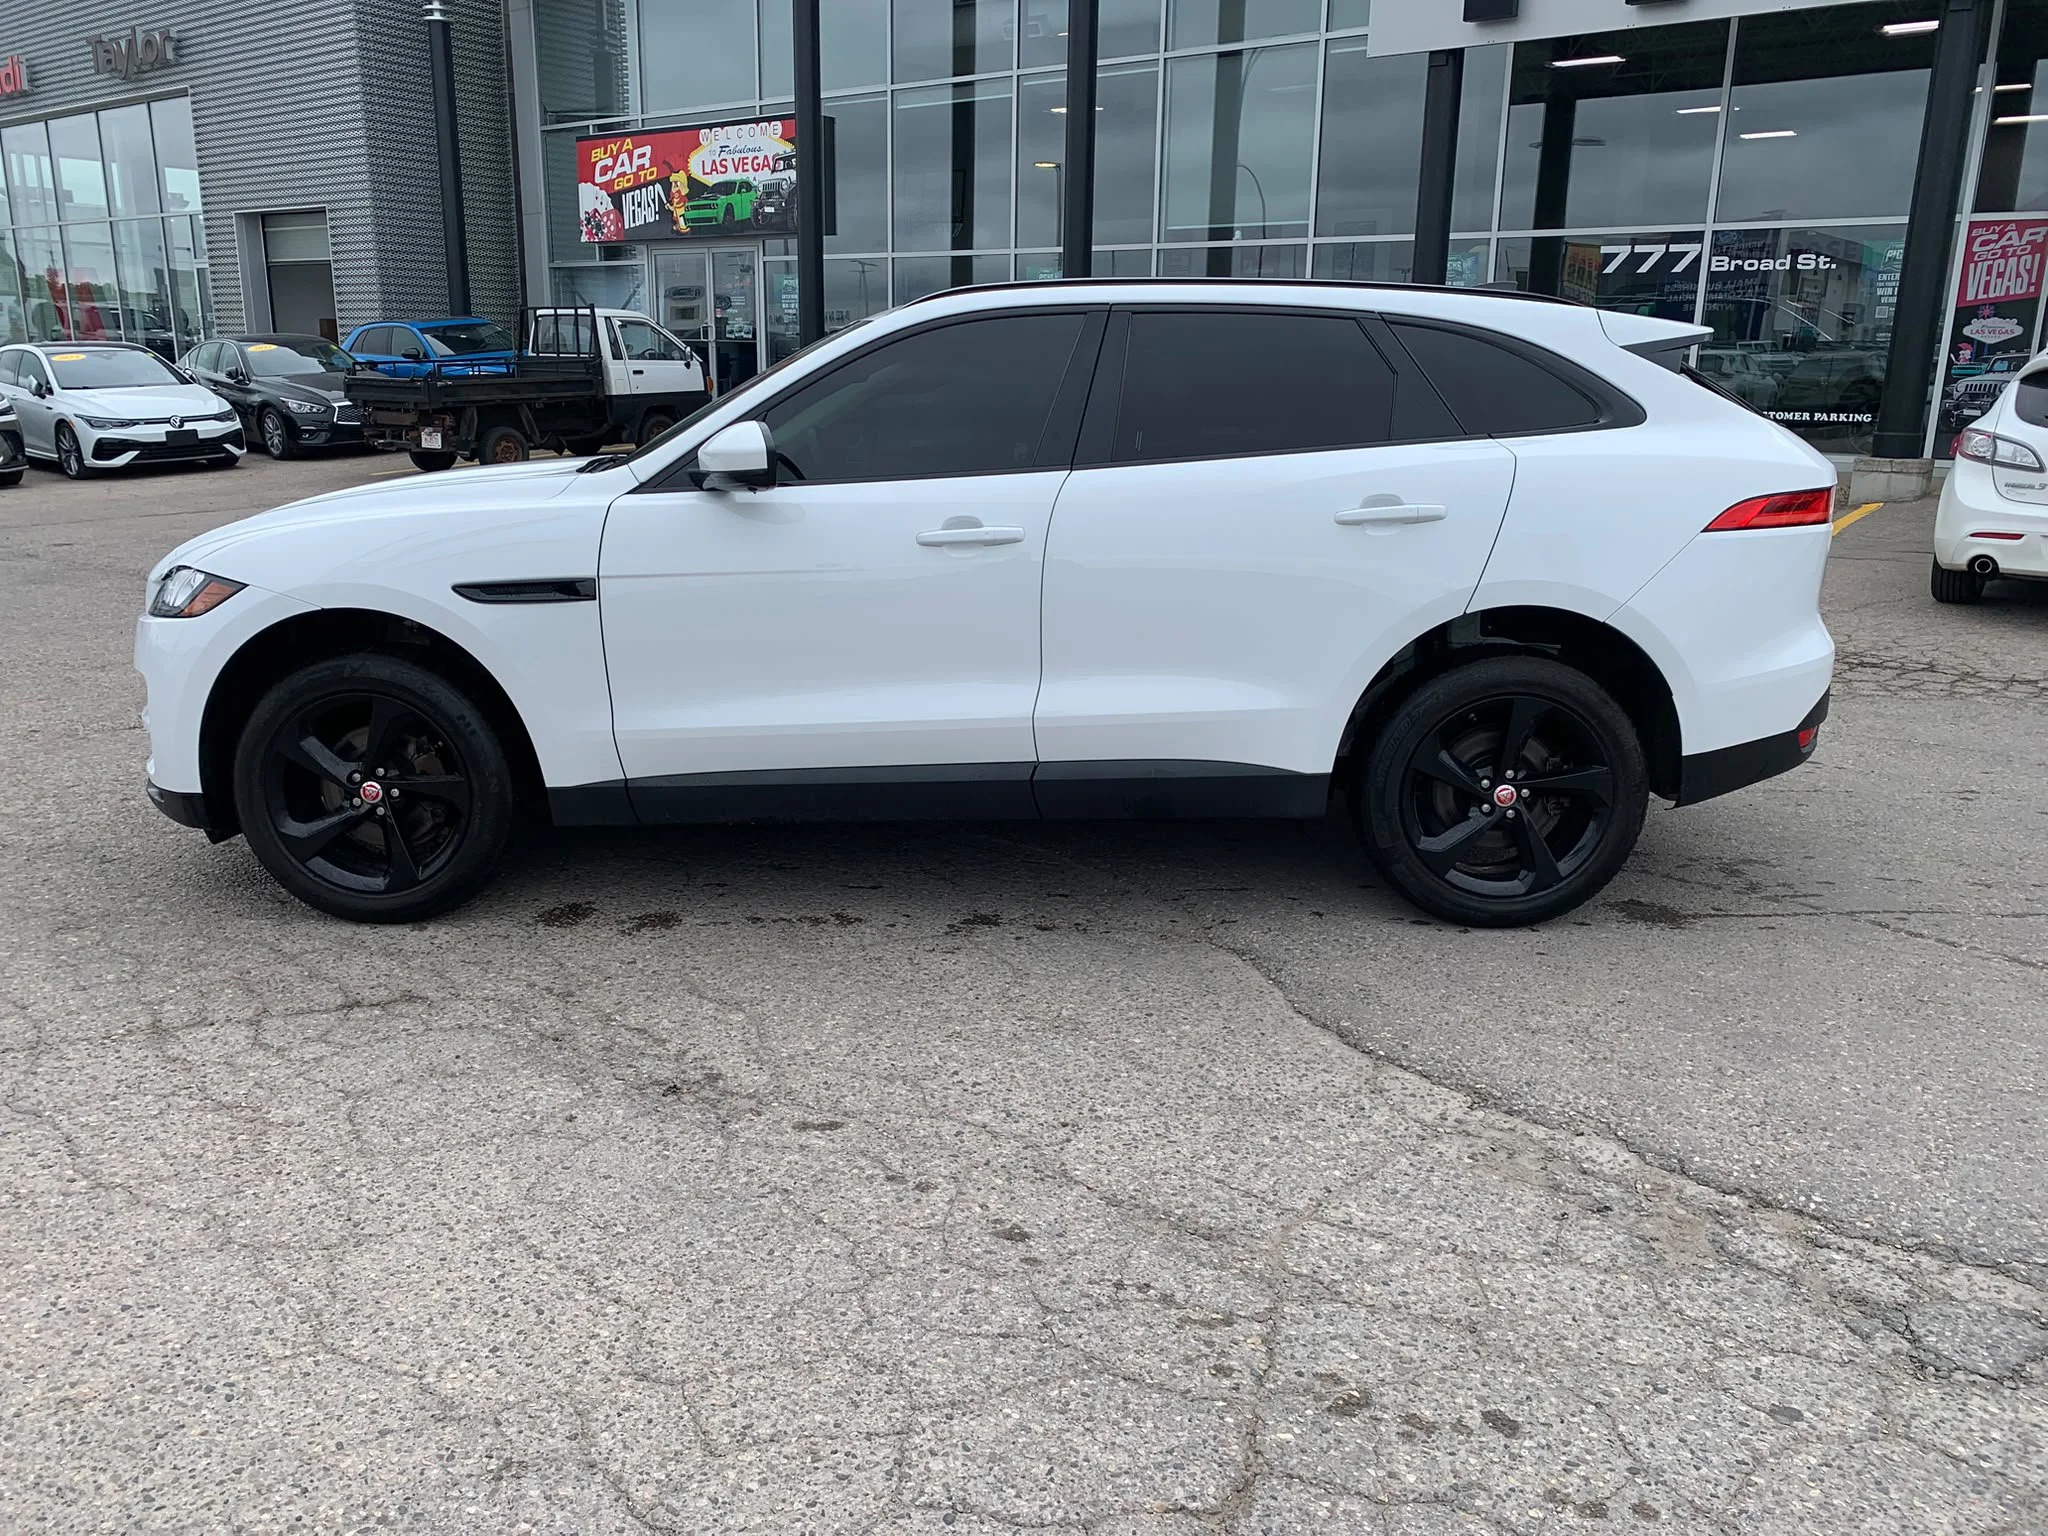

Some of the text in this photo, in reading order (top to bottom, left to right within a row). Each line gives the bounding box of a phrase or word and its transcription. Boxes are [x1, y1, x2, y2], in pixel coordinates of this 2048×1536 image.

[86, 26, 175, 79] Taylor
[0, 54, 25, 94] di
[701, 123, 779, 142] WELCOME
[590, 138, 633, 162] BUY A
[718, 144, 764, 158] Fabulous
[594, 144, 652, 183] CAR
[701, 158, 728, 176] LAS
[613, 166, 658, 191] GO TO
[622, 182, 660, 230] VEGAS!
[1971, 222, 2017, 237] BUY A
[1972, 226, 2048, 253] CAR
[1600, 243, 1702, 274] 777
[1709, 253, 1791, 272] Broad
[1796, 253, 1837, 270] St.
[1974, 244, 2032, 261] GO TO
[1966, 253, 2041, 301] VEGAS!
[1813, 412, 1873, 423] PARKING
